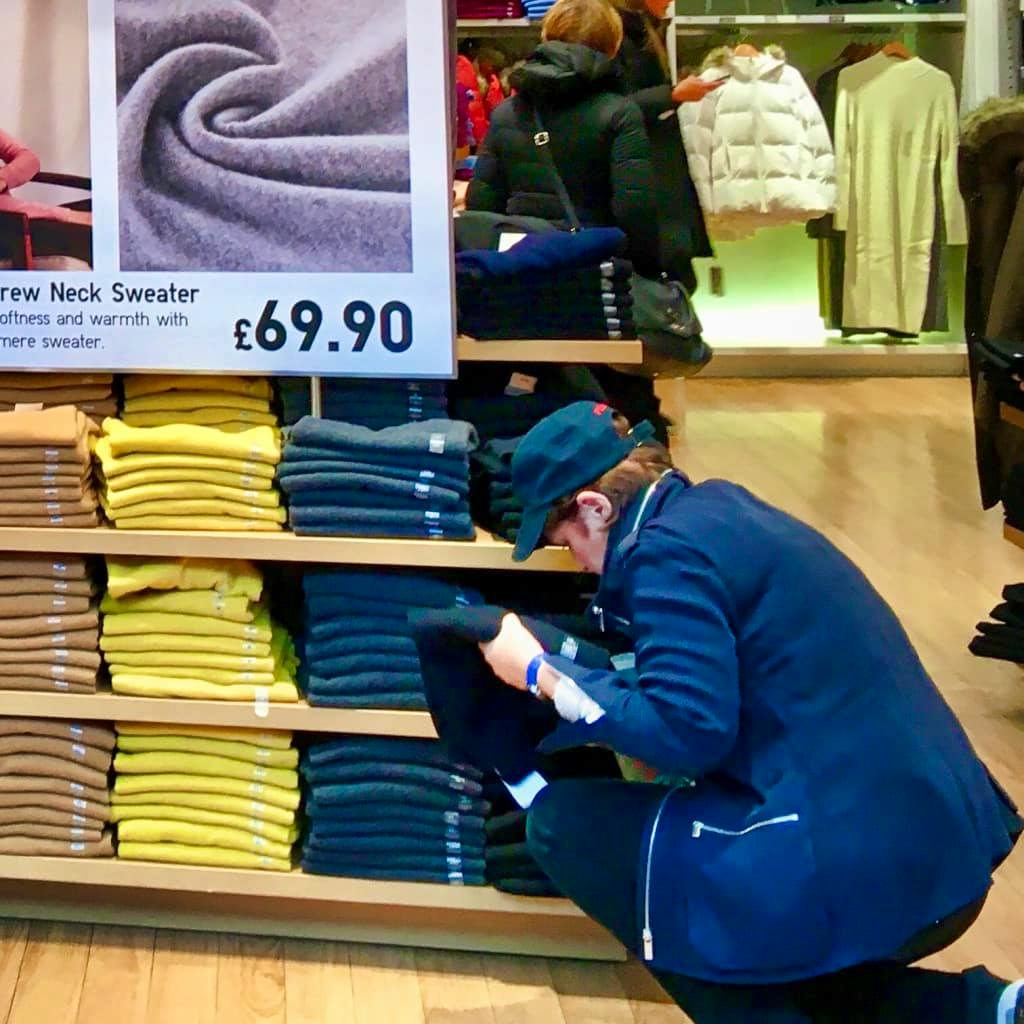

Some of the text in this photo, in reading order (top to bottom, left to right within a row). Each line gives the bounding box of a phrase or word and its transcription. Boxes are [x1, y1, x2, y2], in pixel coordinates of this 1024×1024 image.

[50, 281, 102, 304] Neck
[111, 282, 200, 304] Sweater
[56, 311, 84, 326] and
[89, 311, 150, 327] warmth
[156, 312, 189, 327] with
[234, 299, 413, 354] £69.90
[42, 334, 105, 350] sweater.
